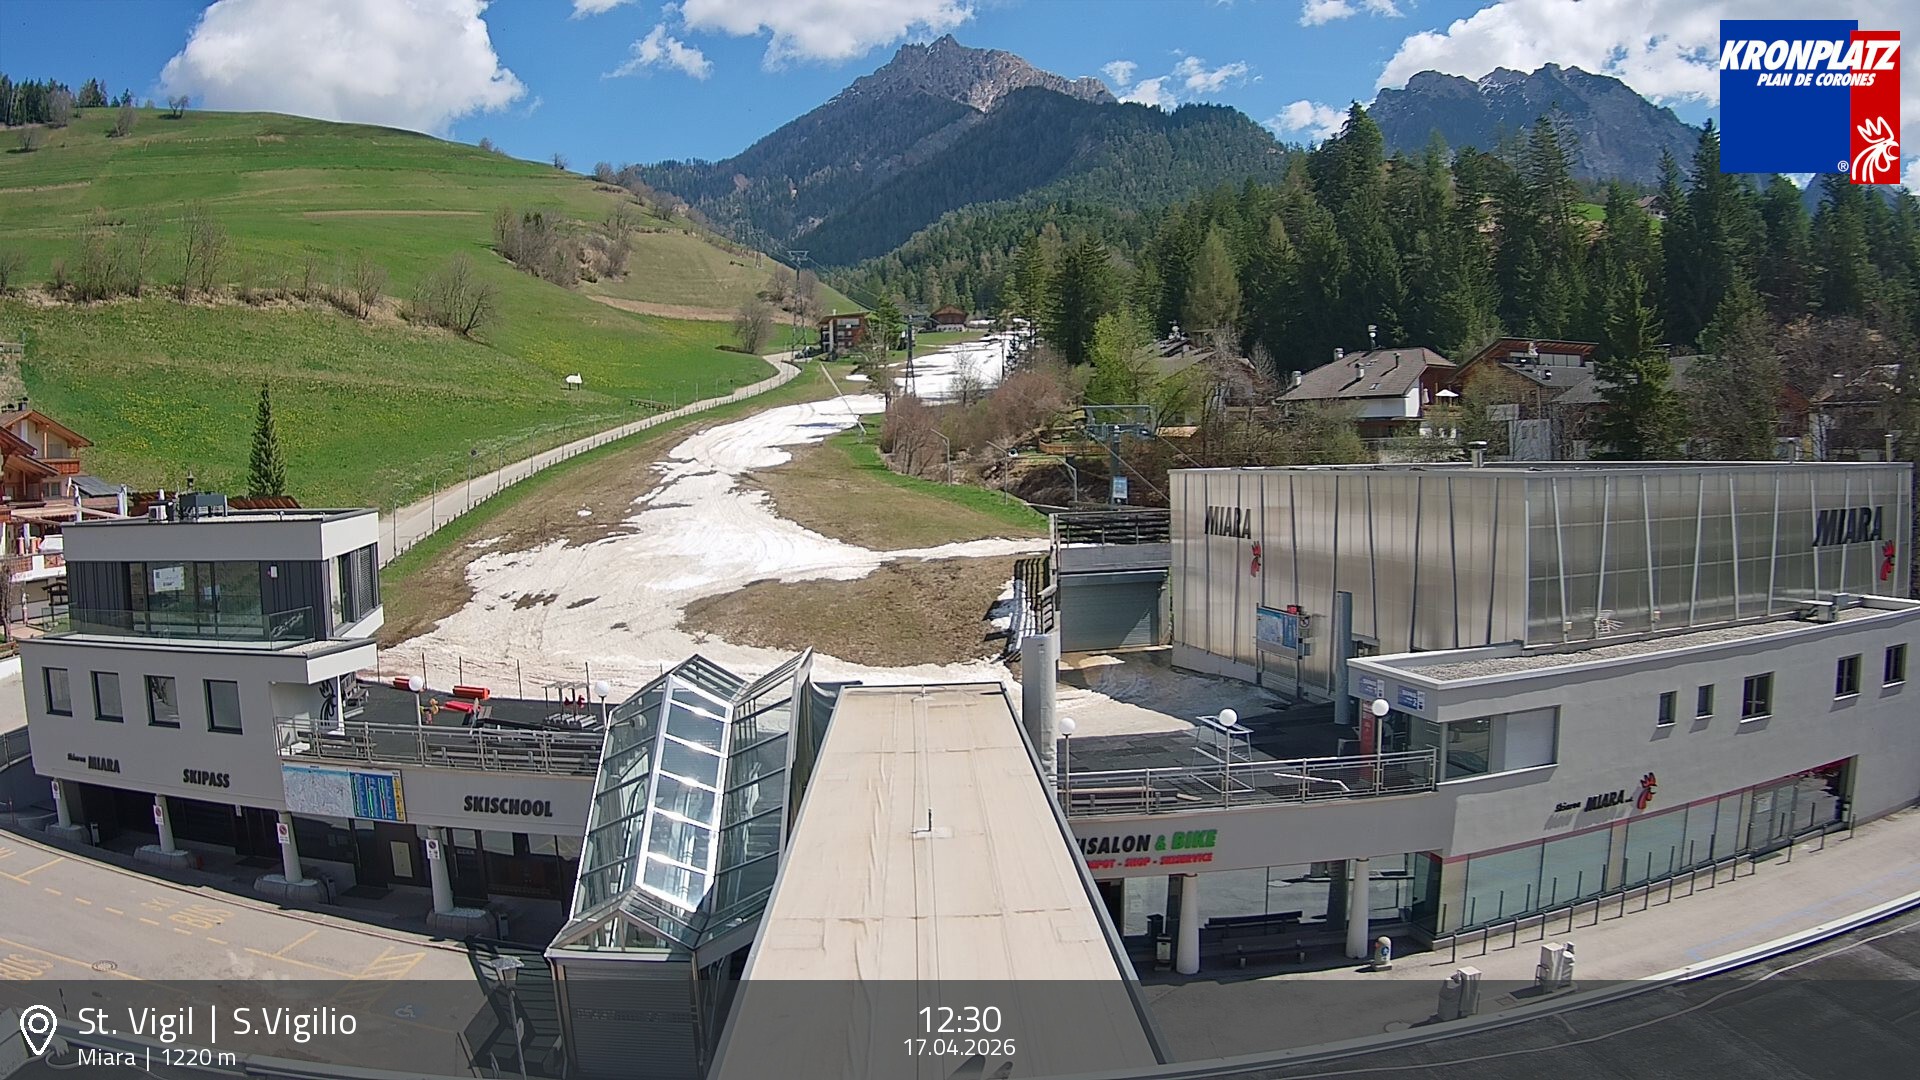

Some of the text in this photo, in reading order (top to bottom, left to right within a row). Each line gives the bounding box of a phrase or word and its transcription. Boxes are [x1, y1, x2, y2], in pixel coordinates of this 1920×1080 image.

[1205, 506, 1252, 539] MIARA
[1811, 505, 1884, 547] MIARA
[88, 755, 121, 774] MIARA
[183, 768, 230, 788] SKIPASS
[463, 795, 553, 817] SKISCHOOL
[1584, 789, 1626, 812] MIARA
[1076, 829, 1217, 855] ISALON & BIKE
[169, 904, 235, 929] BUS
